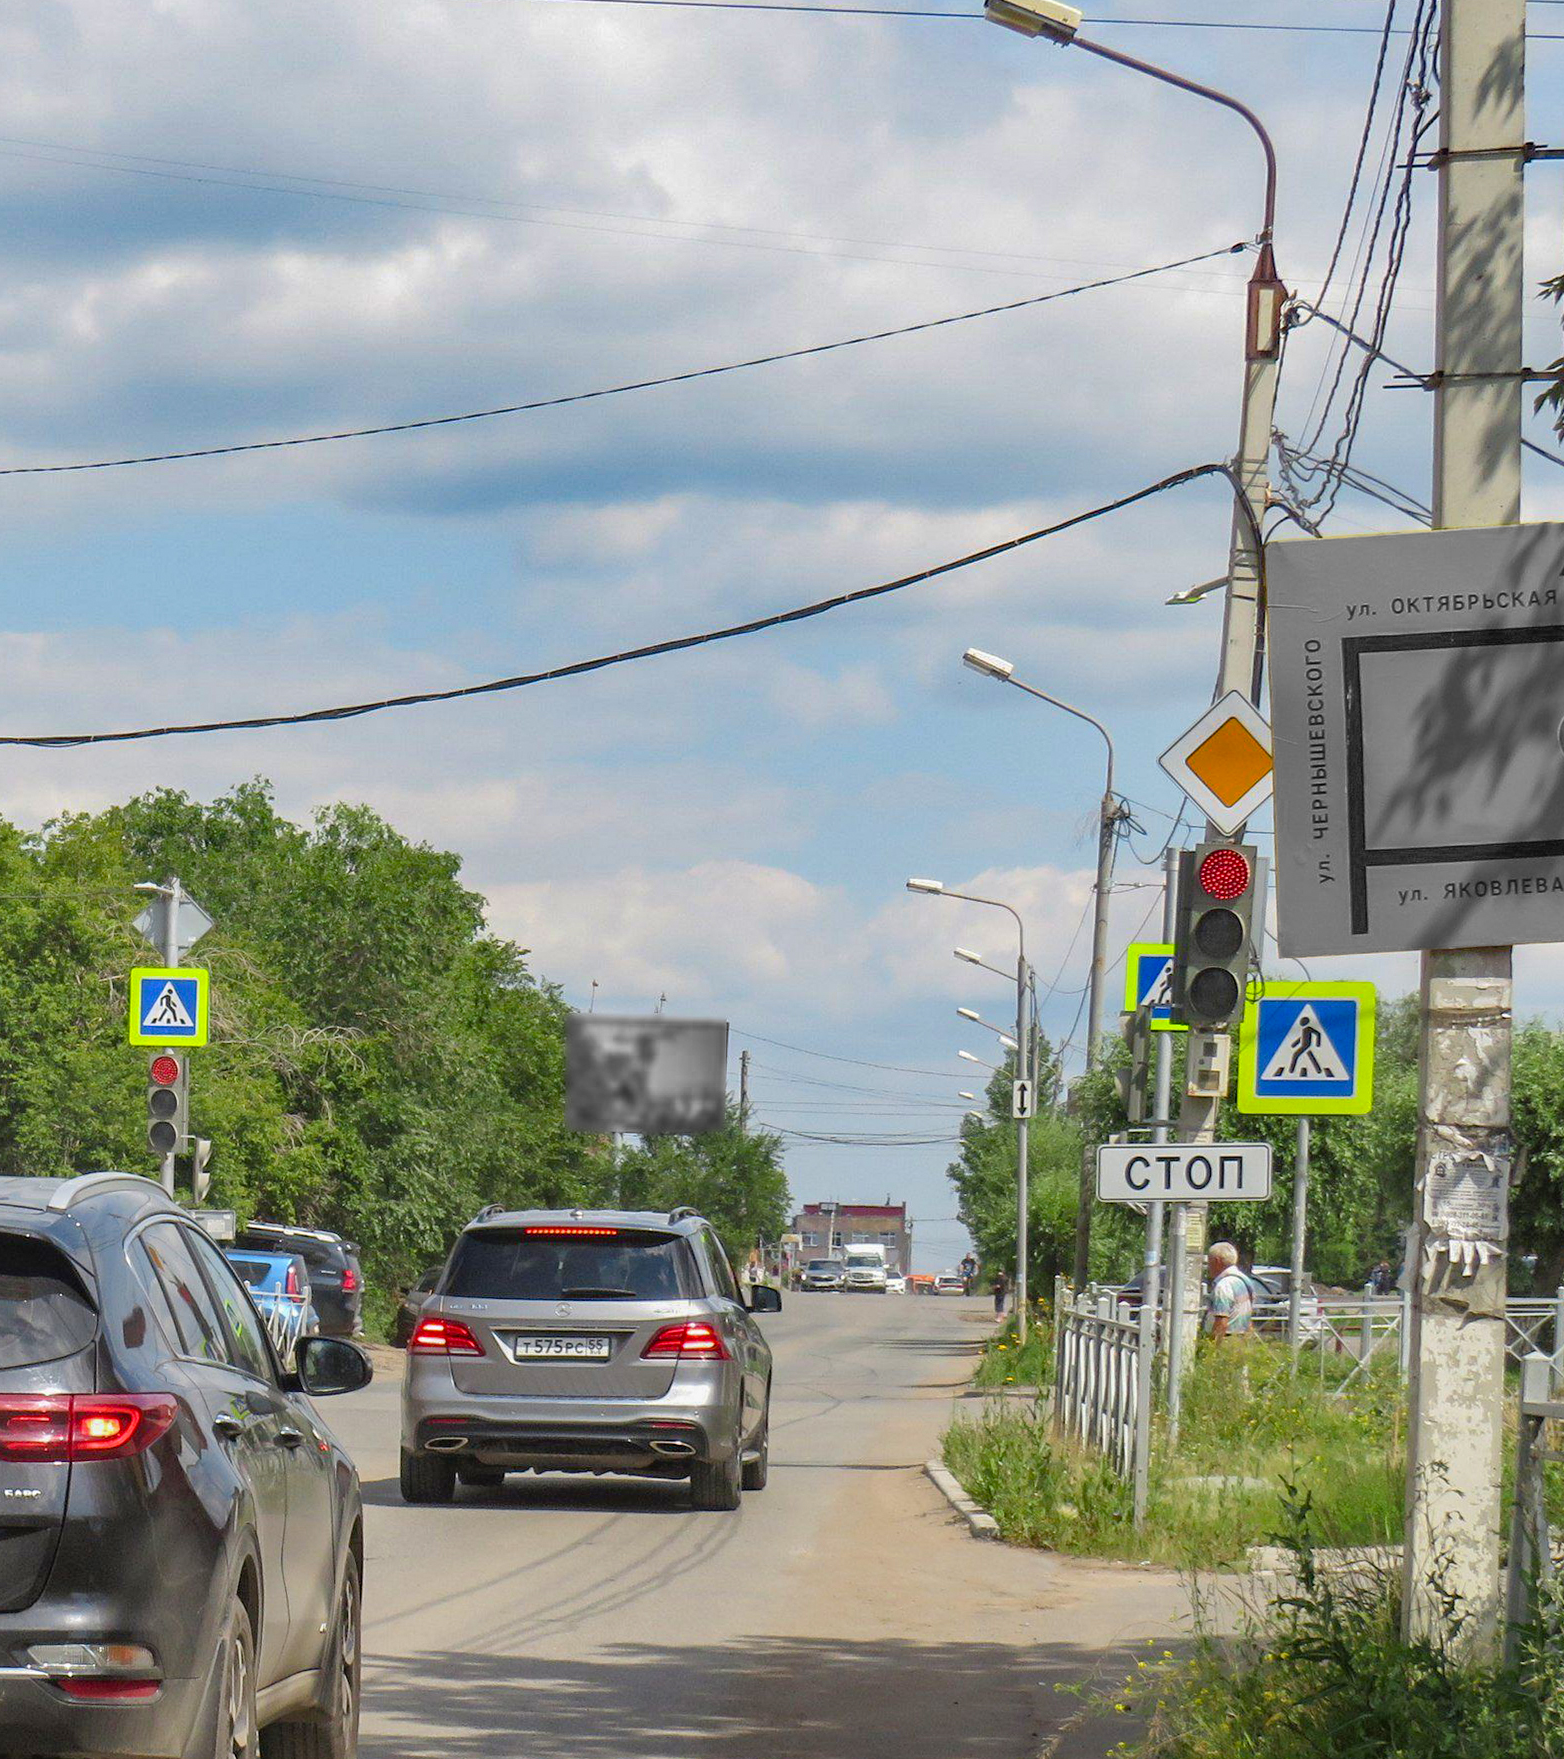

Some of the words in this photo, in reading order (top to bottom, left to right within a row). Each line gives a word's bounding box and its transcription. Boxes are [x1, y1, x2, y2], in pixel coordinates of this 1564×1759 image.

[1346, 603, 1377, 621] ул.
[1391, 588, 1557, 616] ОКТЯБРЬСКАЯ
[1304, 639, 1329, 840] ЧЕРНЫШЕВСКОГО
[1318, 853, 1335, 884] ул.
[1398, 889, 1428, 906] ул.
[1444, 876, 1564, 900] ЯКОВЛЕВА
[1124, 1155, 1244, 1191] СТОП
[588, 1339, 604, 1350] 55
